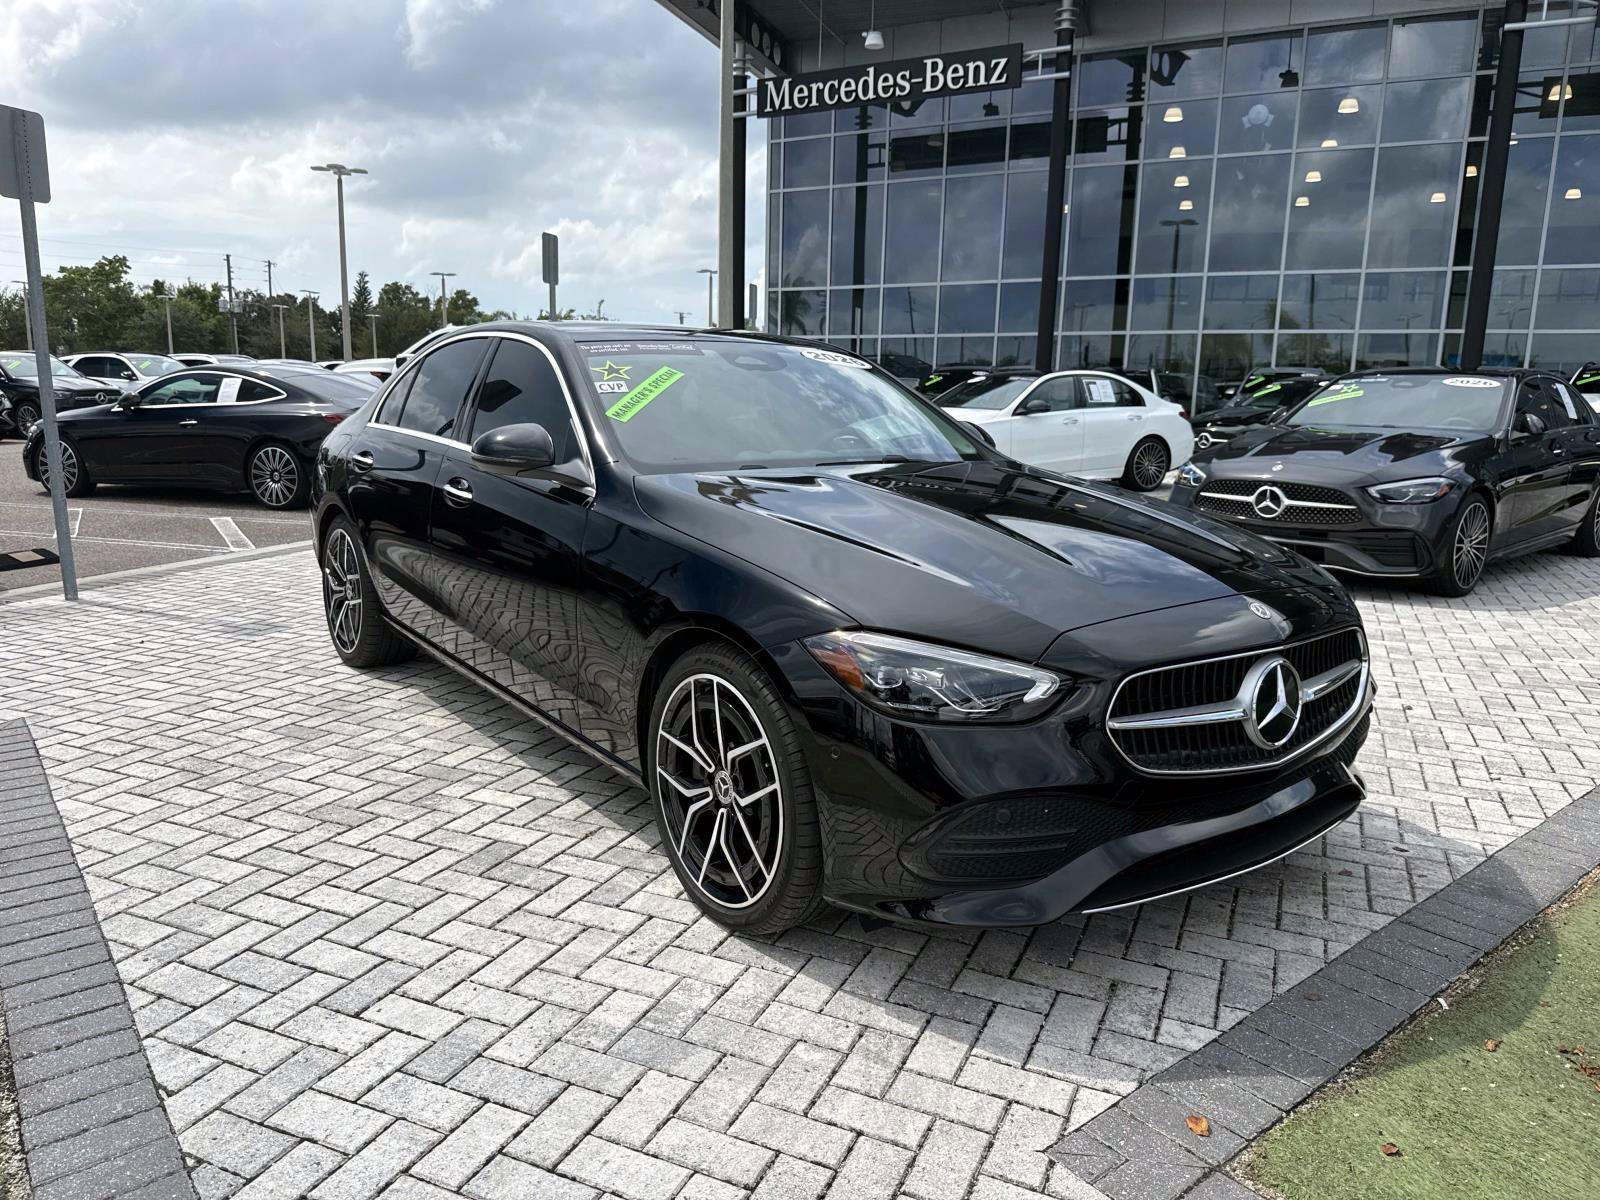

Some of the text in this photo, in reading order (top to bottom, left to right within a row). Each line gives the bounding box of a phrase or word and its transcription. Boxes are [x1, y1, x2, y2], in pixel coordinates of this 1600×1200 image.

[764, 57, 1009, 112] Mercedes-Benz
[598, 383, 624, 391] CVP
[611, 369, 678, 419] MANAGER'S SPECIAL
[1449, 378, 1493, 387] 2026
